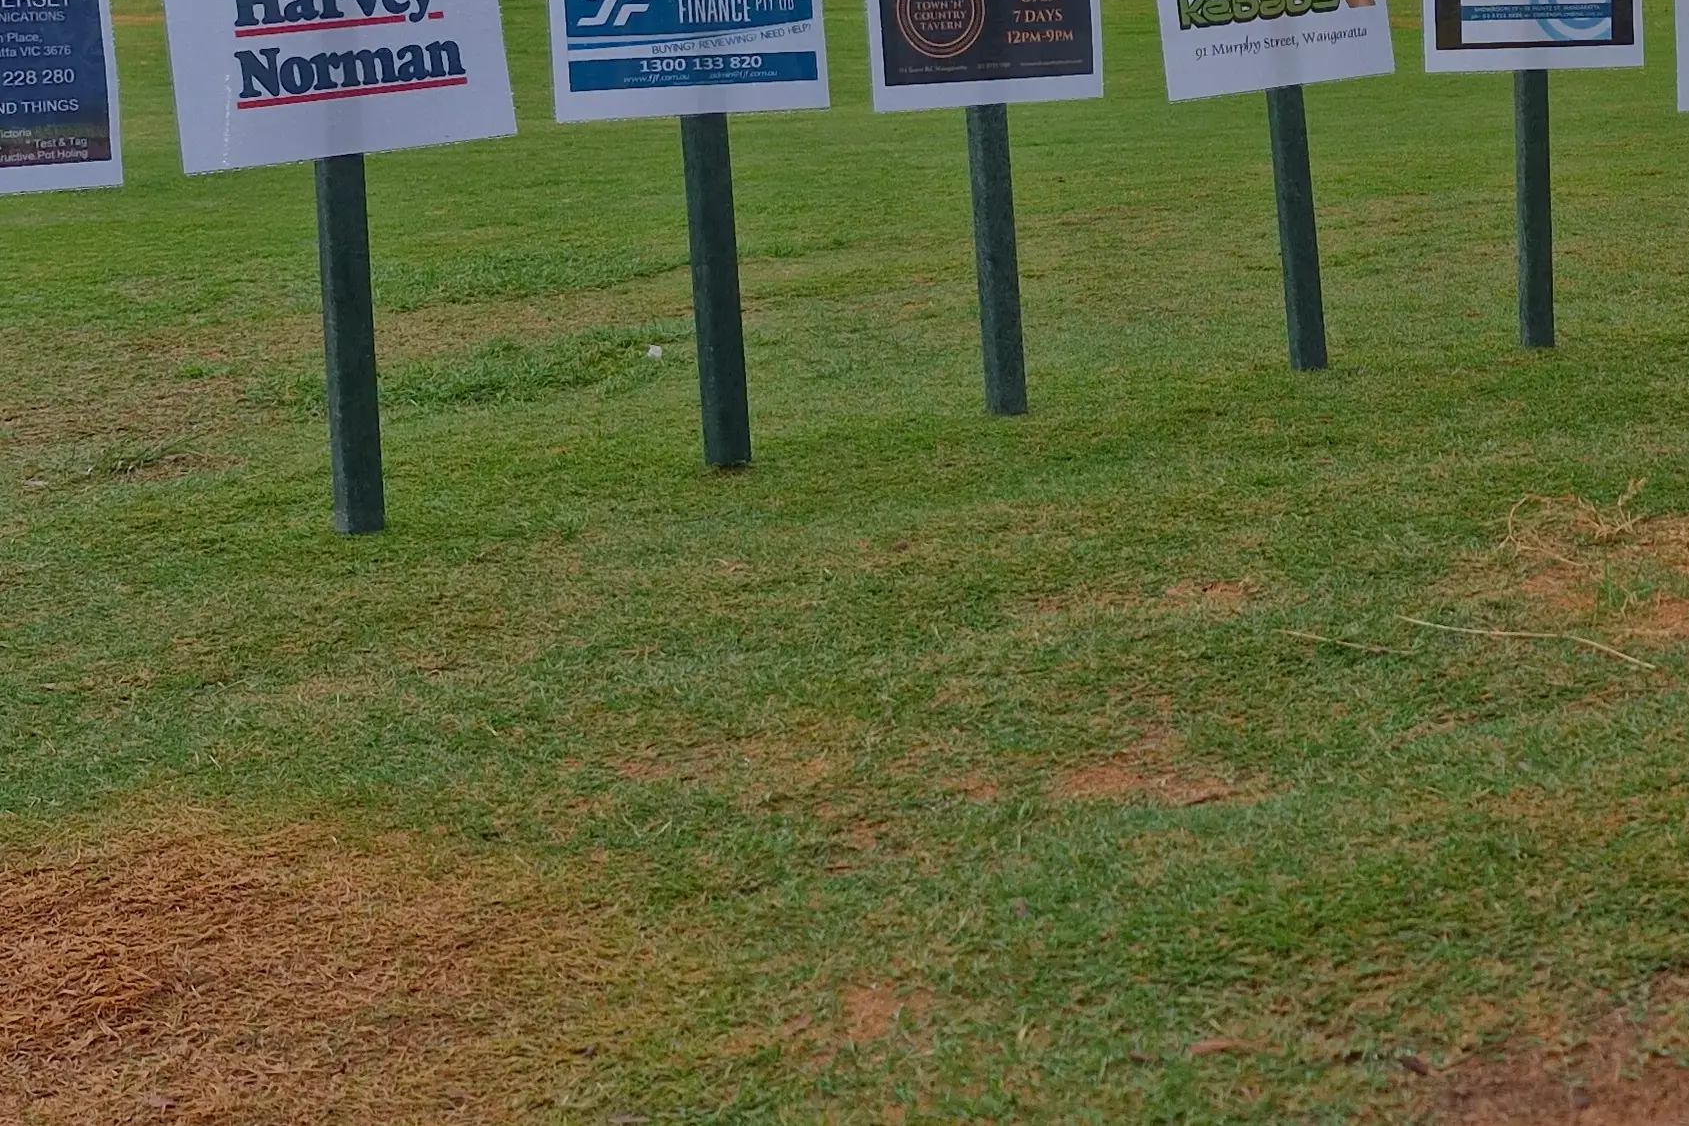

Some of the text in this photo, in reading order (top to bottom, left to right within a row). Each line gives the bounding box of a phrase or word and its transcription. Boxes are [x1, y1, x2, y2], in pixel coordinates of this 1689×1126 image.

[915, 1, 949, 11] TOWN
[914, 10, 967, 21] COUNTRY
[1012, 8, 1063, 23] 7 DAYS
[919, 21, 962, 31] TAVERN
[7, 32, 43, 44] Place,
[651, 23, 812, 55] BUYING? REVIEWING? NEED HELP?
[1195, 26, 1368, 61] 91 Murphy Street, Wangaratta
[20, 45, 41, 57] VIC
[43, 44, 71, 56] 3676
[234, 39, 466, 99] Norman
[639, 55, 763, 73] 1300 133 820
[3, 68, 75, 86] 228 280
[21, 98, 79, 113] THINGS
[33, 137, 88, 149] Test & Tag
[37, 151, 55, 161] Pot
[57, 149, 89, 160] Holing
